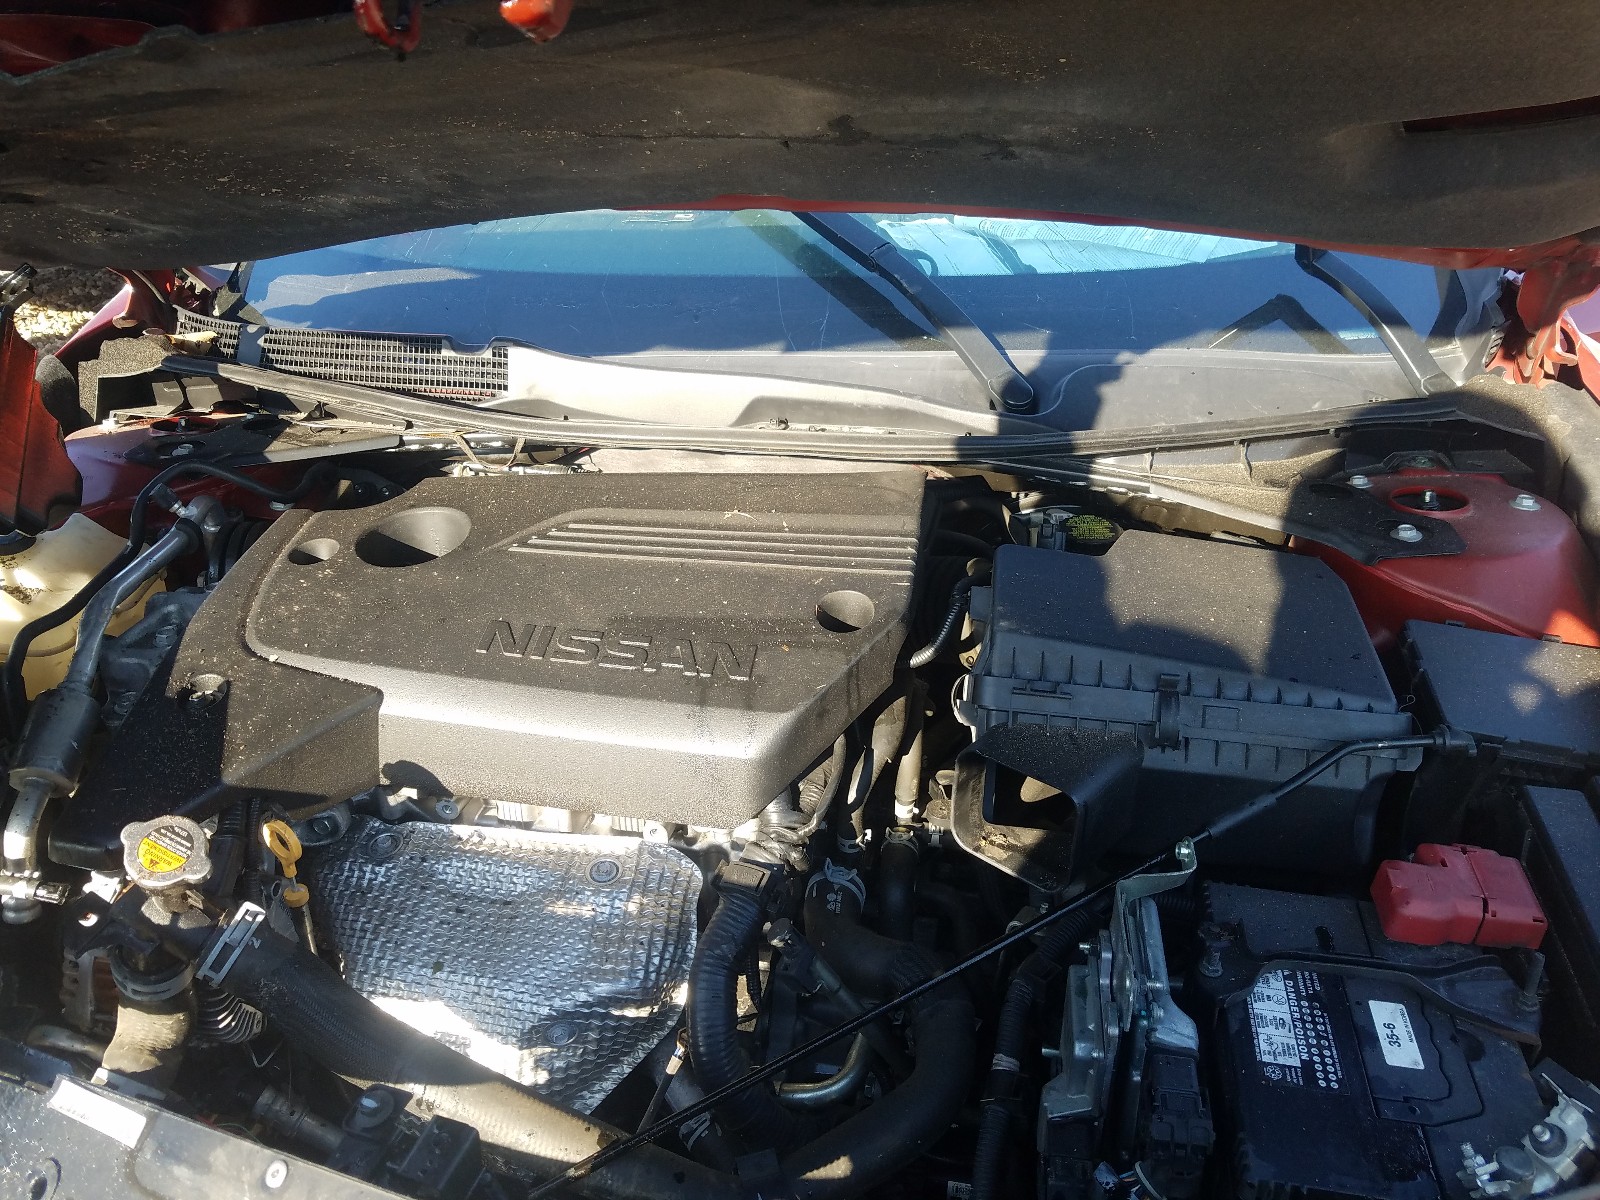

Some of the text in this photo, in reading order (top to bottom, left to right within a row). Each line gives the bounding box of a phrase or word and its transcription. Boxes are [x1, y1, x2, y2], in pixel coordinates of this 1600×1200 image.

[475, 619, 759, 681] NISSAN
[143, 841, 183, 864] AVERTISSEMENT
[144, 849, 173, 866] WARNING
[1286, 980, 1309, 1061] DANGER/POISON
[1383, 1022, 1402, 1048] 35-6
